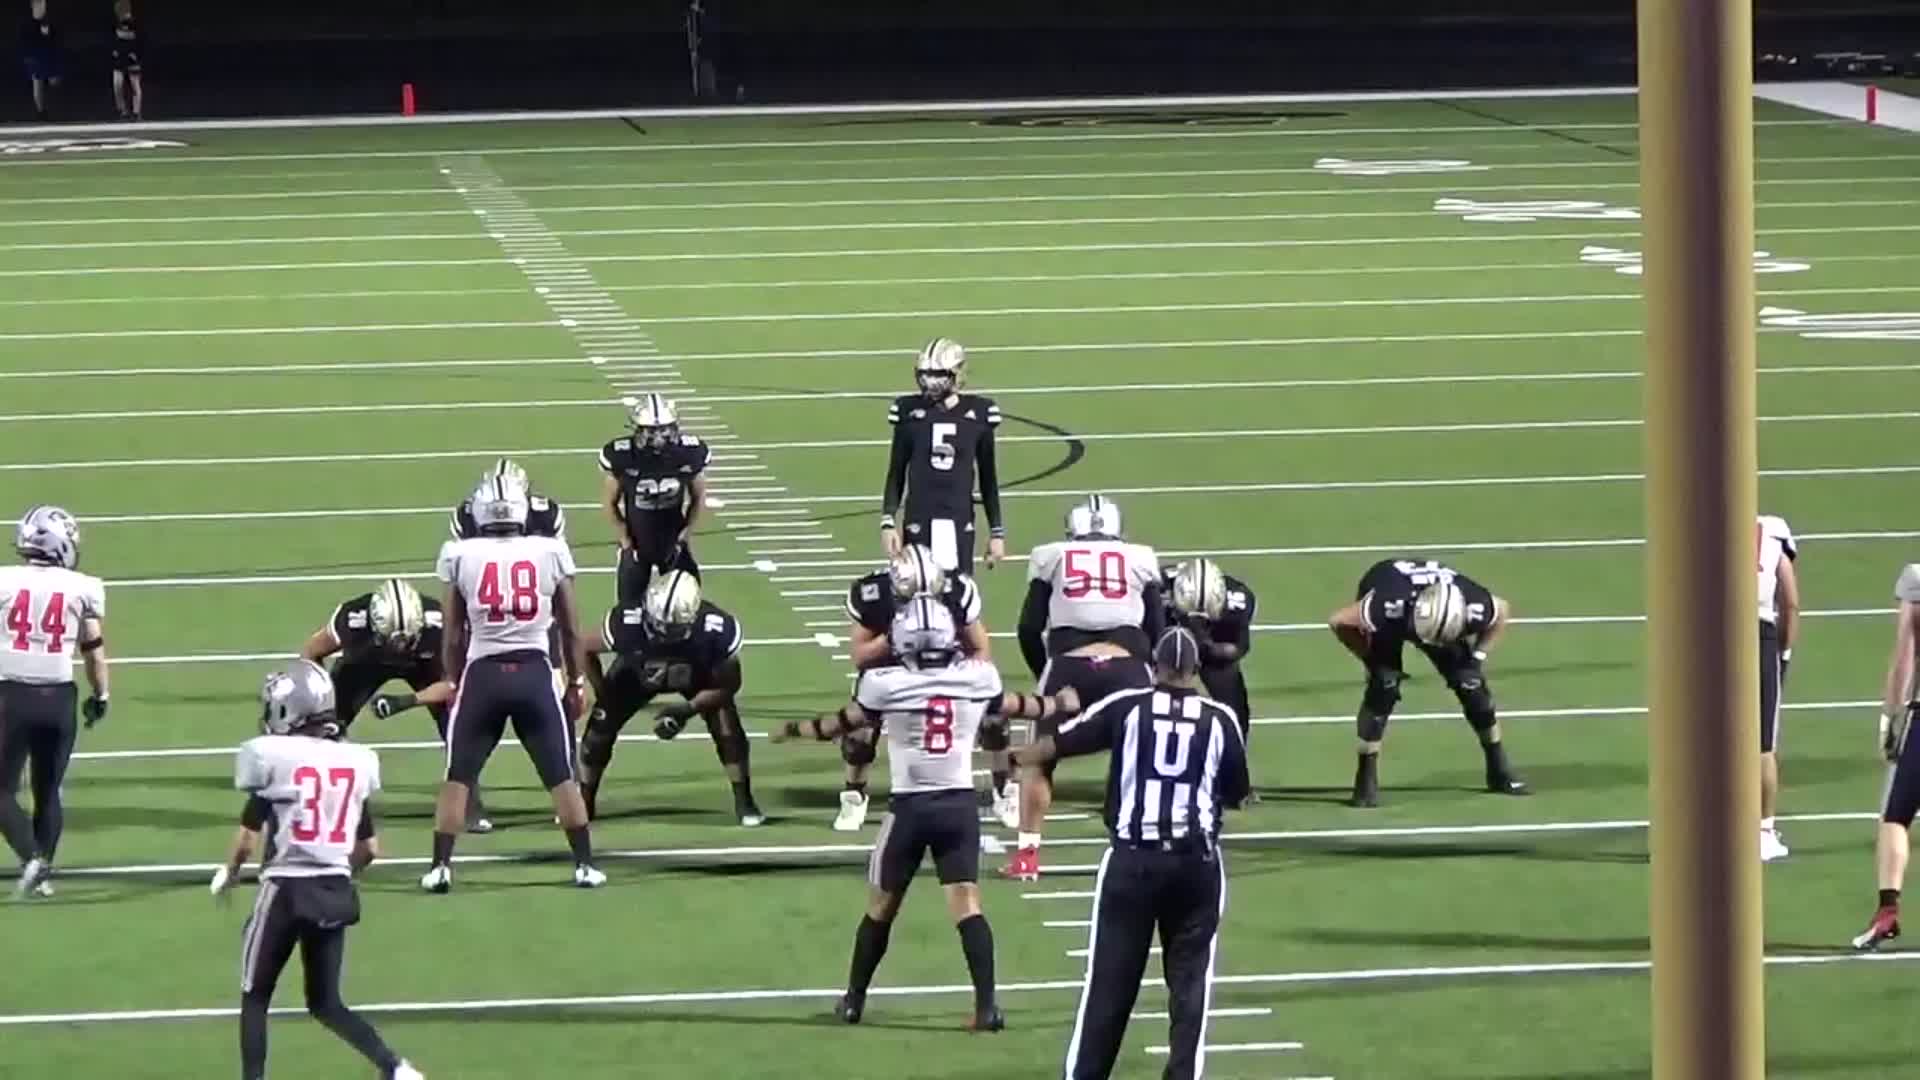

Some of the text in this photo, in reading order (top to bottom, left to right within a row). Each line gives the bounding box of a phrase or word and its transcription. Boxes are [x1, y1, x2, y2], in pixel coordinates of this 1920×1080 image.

[930, 422, 957, 471] 5
[477, 558, 541, 624] 48
[1062, 549, 1128, 599] 50
[6, 588, 67, 654] 44
[923, 694, 955, 756] 8
[1152, 719, 1196, 777] U
[291, 764, 356, 845] 37
